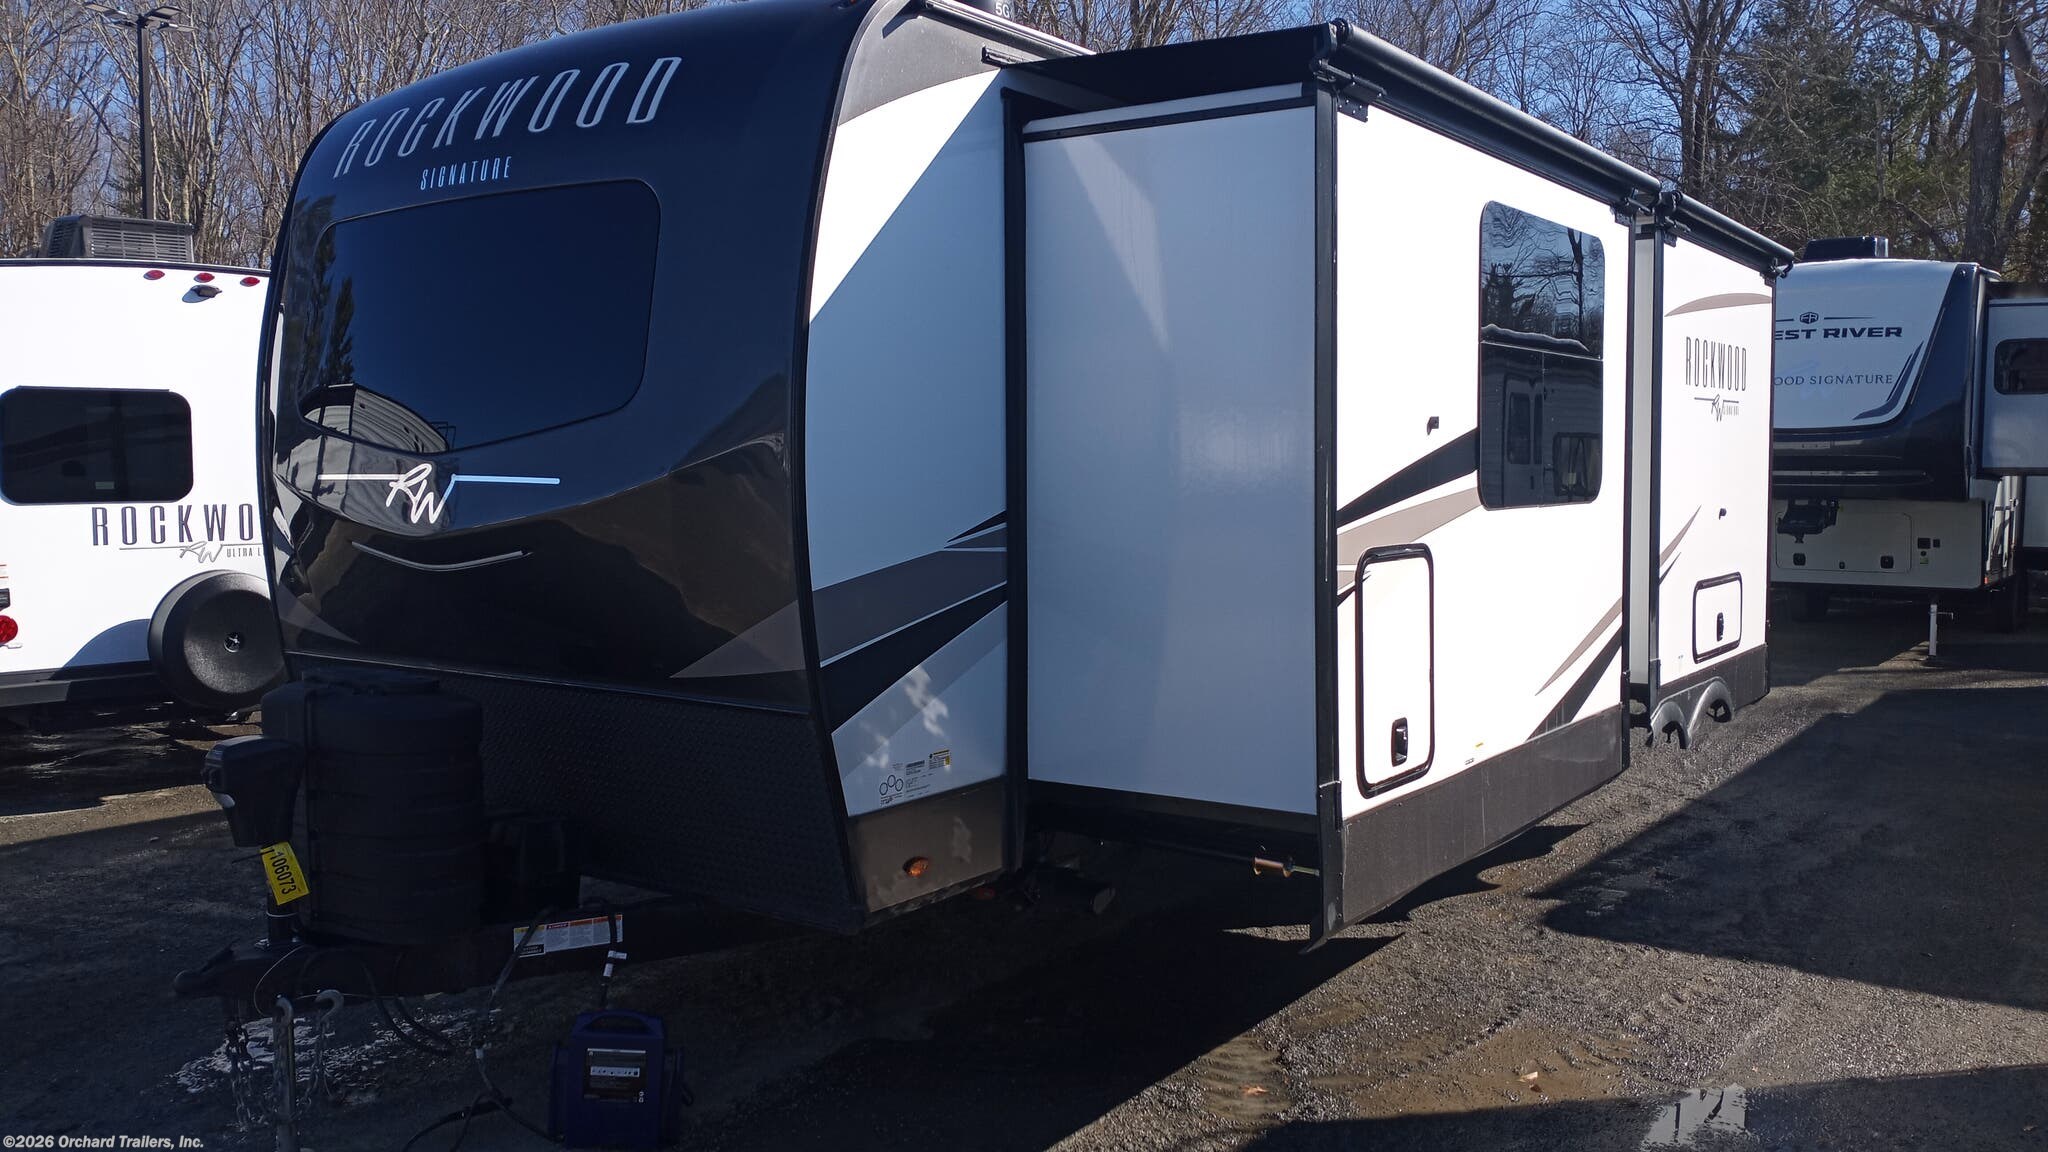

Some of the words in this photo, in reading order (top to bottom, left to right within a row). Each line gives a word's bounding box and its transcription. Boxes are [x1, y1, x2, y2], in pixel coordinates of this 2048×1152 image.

[995, 2, 1010, 18] 5G
[333, 56, 682, 179] ROCKWOOD
[420, 156, 513, 191] SIGNATURE
[1774, 328, 1817, 340] EST
[1823, 326, 1903, 339] RIVER
[1685, 336, 1747, 391] ROCKWOOD
[1809, 374, 1893, 385] SIGNATURE
[91, 503, 255, 546] ROCKWO
[226, 547, 254, 558] ULTRA
